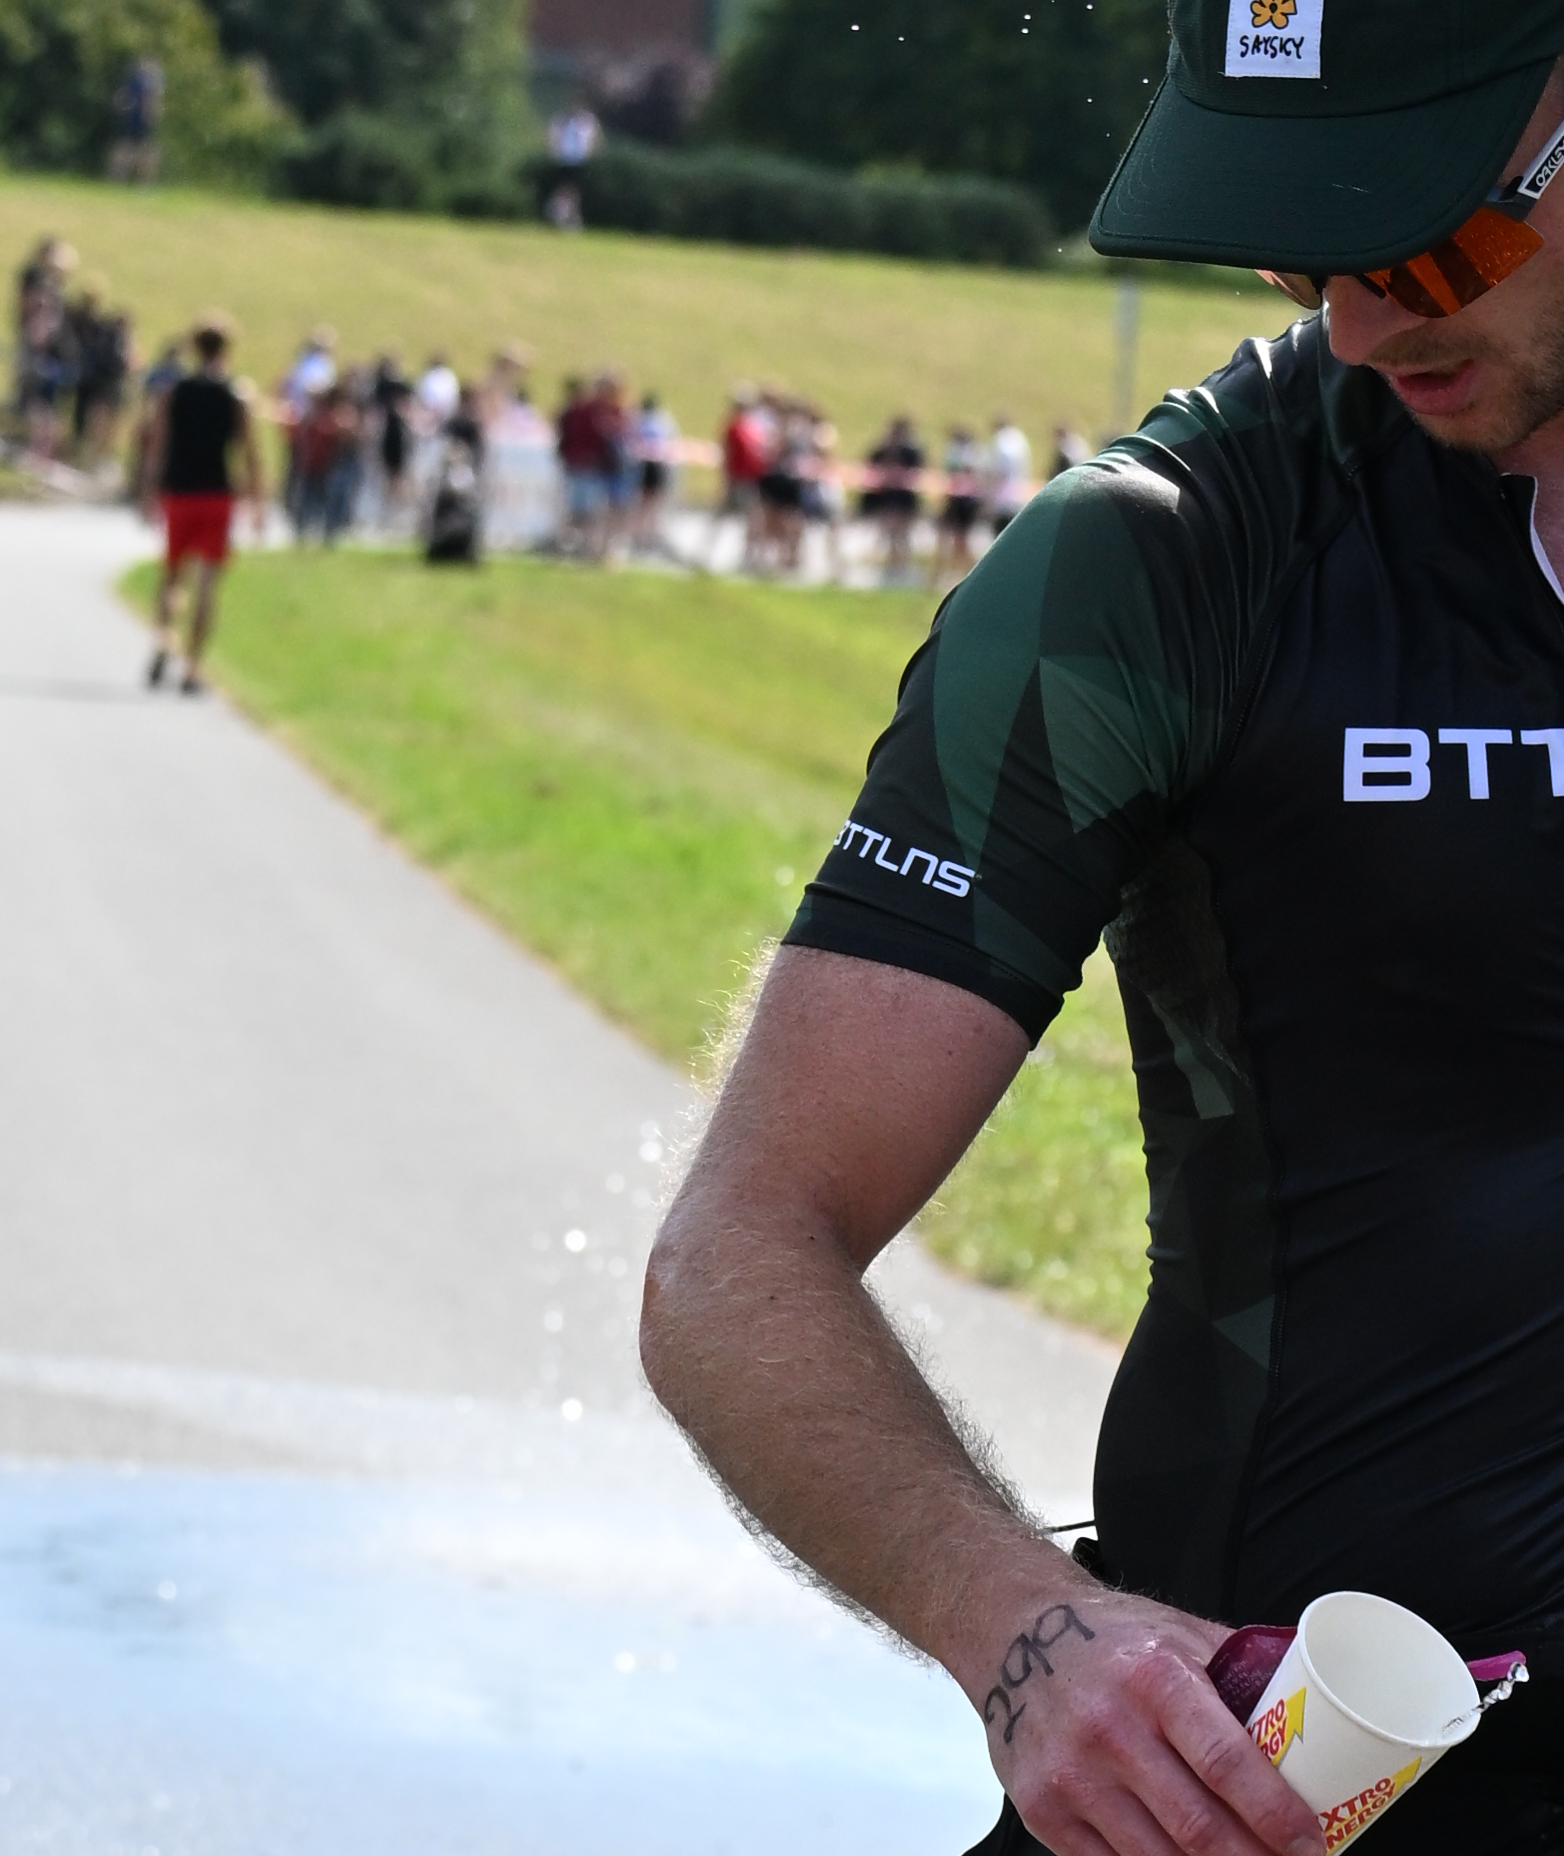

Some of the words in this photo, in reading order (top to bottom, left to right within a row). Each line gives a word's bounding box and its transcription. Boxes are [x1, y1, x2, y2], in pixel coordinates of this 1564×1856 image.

[1240, 34, 1304, 59] SAYSKY
[984, 1604, 1096, 1744] 299
[1247, 1698, 1285, 1745] XTRO
[1316, 1777, 1391, 1832] XTRO
[1326, 1783, 1395, 1850] NERGY
